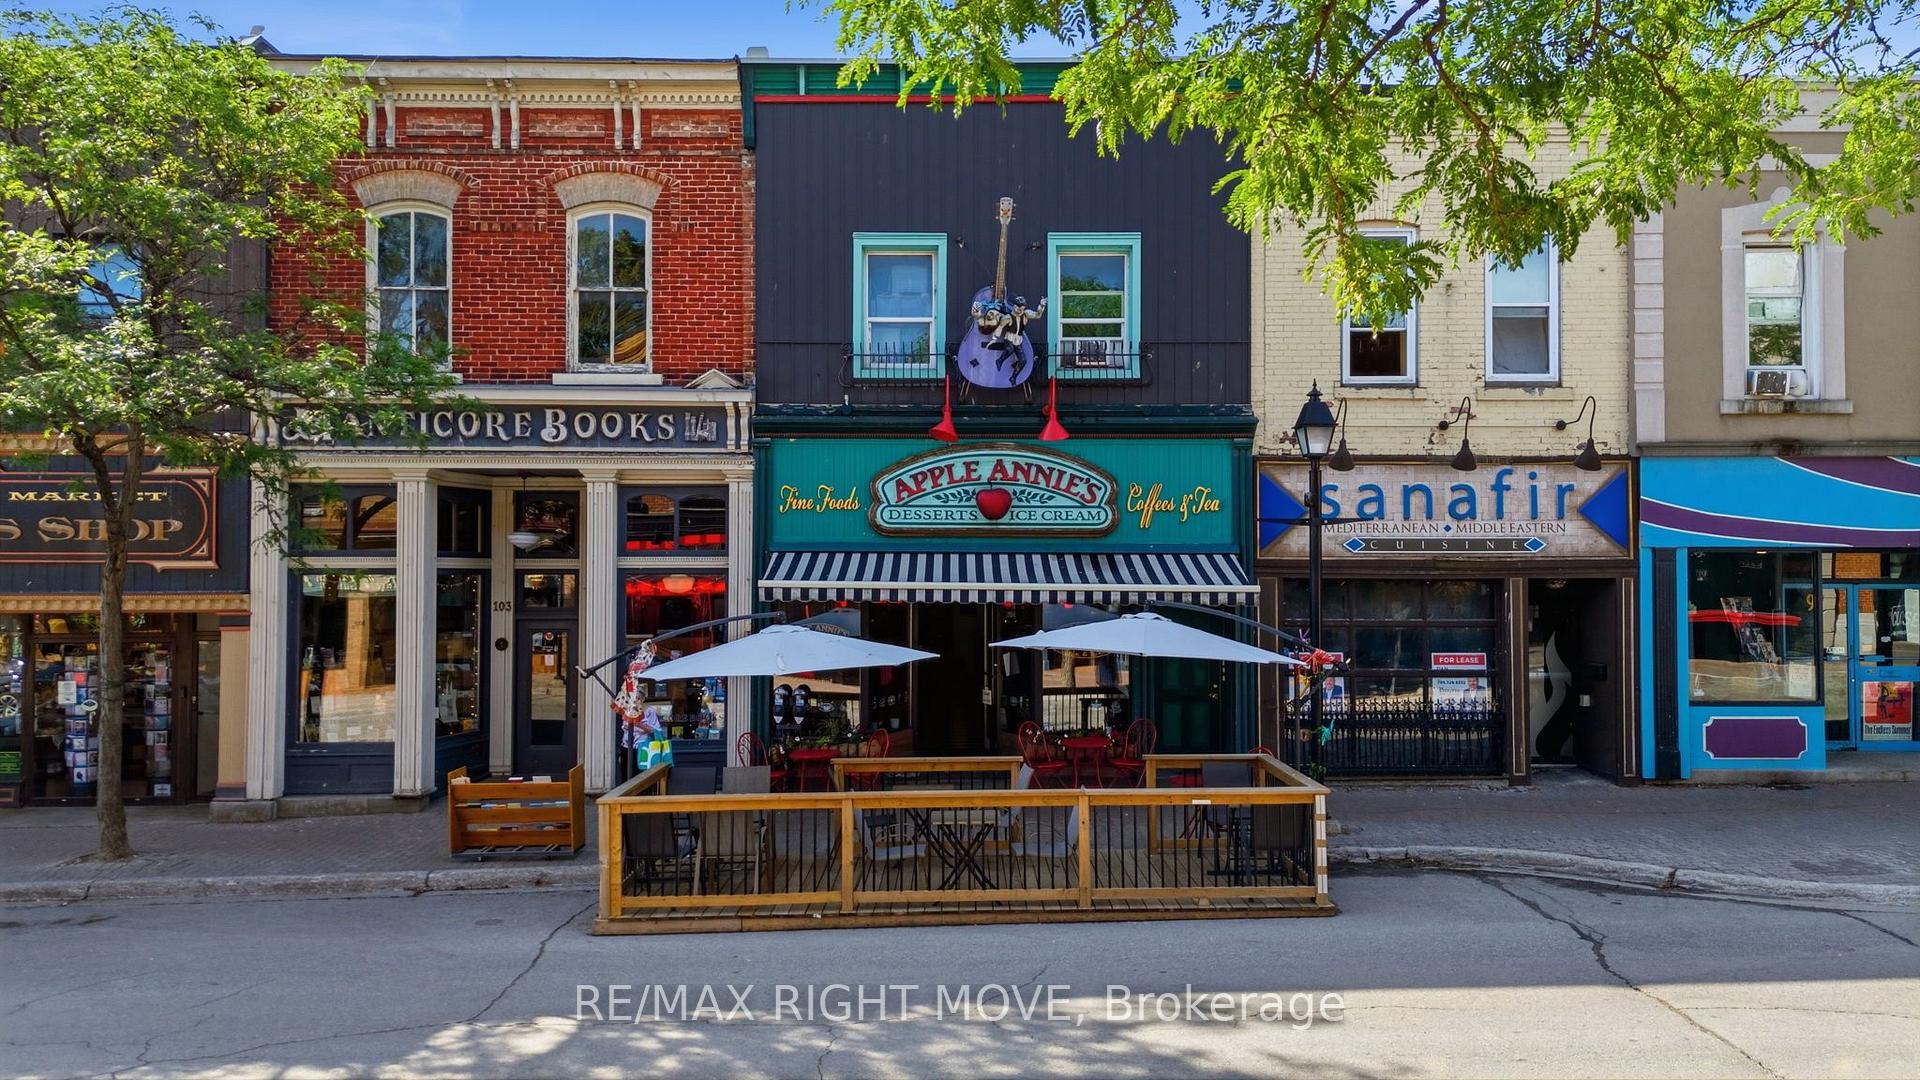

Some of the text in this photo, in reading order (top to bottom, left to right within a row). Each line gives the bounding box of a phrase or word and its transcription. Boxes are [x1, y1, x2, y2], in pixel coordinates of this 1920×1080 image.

[282, 407, 676, 446] ATICORE BOOKS
[895, 459, 1102, 504] APPLE ANNIE'S
[9, 491, 168, 501] MART
[780, 485, 859, 513] Fine Foods
[1321, 468, 1574, 520] sanafir
[888, 509, 1101, 521] DESSERTS ICE CREAM
[1127, 483, 1219, 528] Coffees & Tea
[37, 516, 184, 542] SHOP
[1324, 522, 1566, 534] MEDITERRANEAN MIDDLE EASTERN
[1370, 540, 1518, 549] CUISINE
[493, 601, 512, 611] 103
[1439, 656, 1479, 664] FOR LEASE
